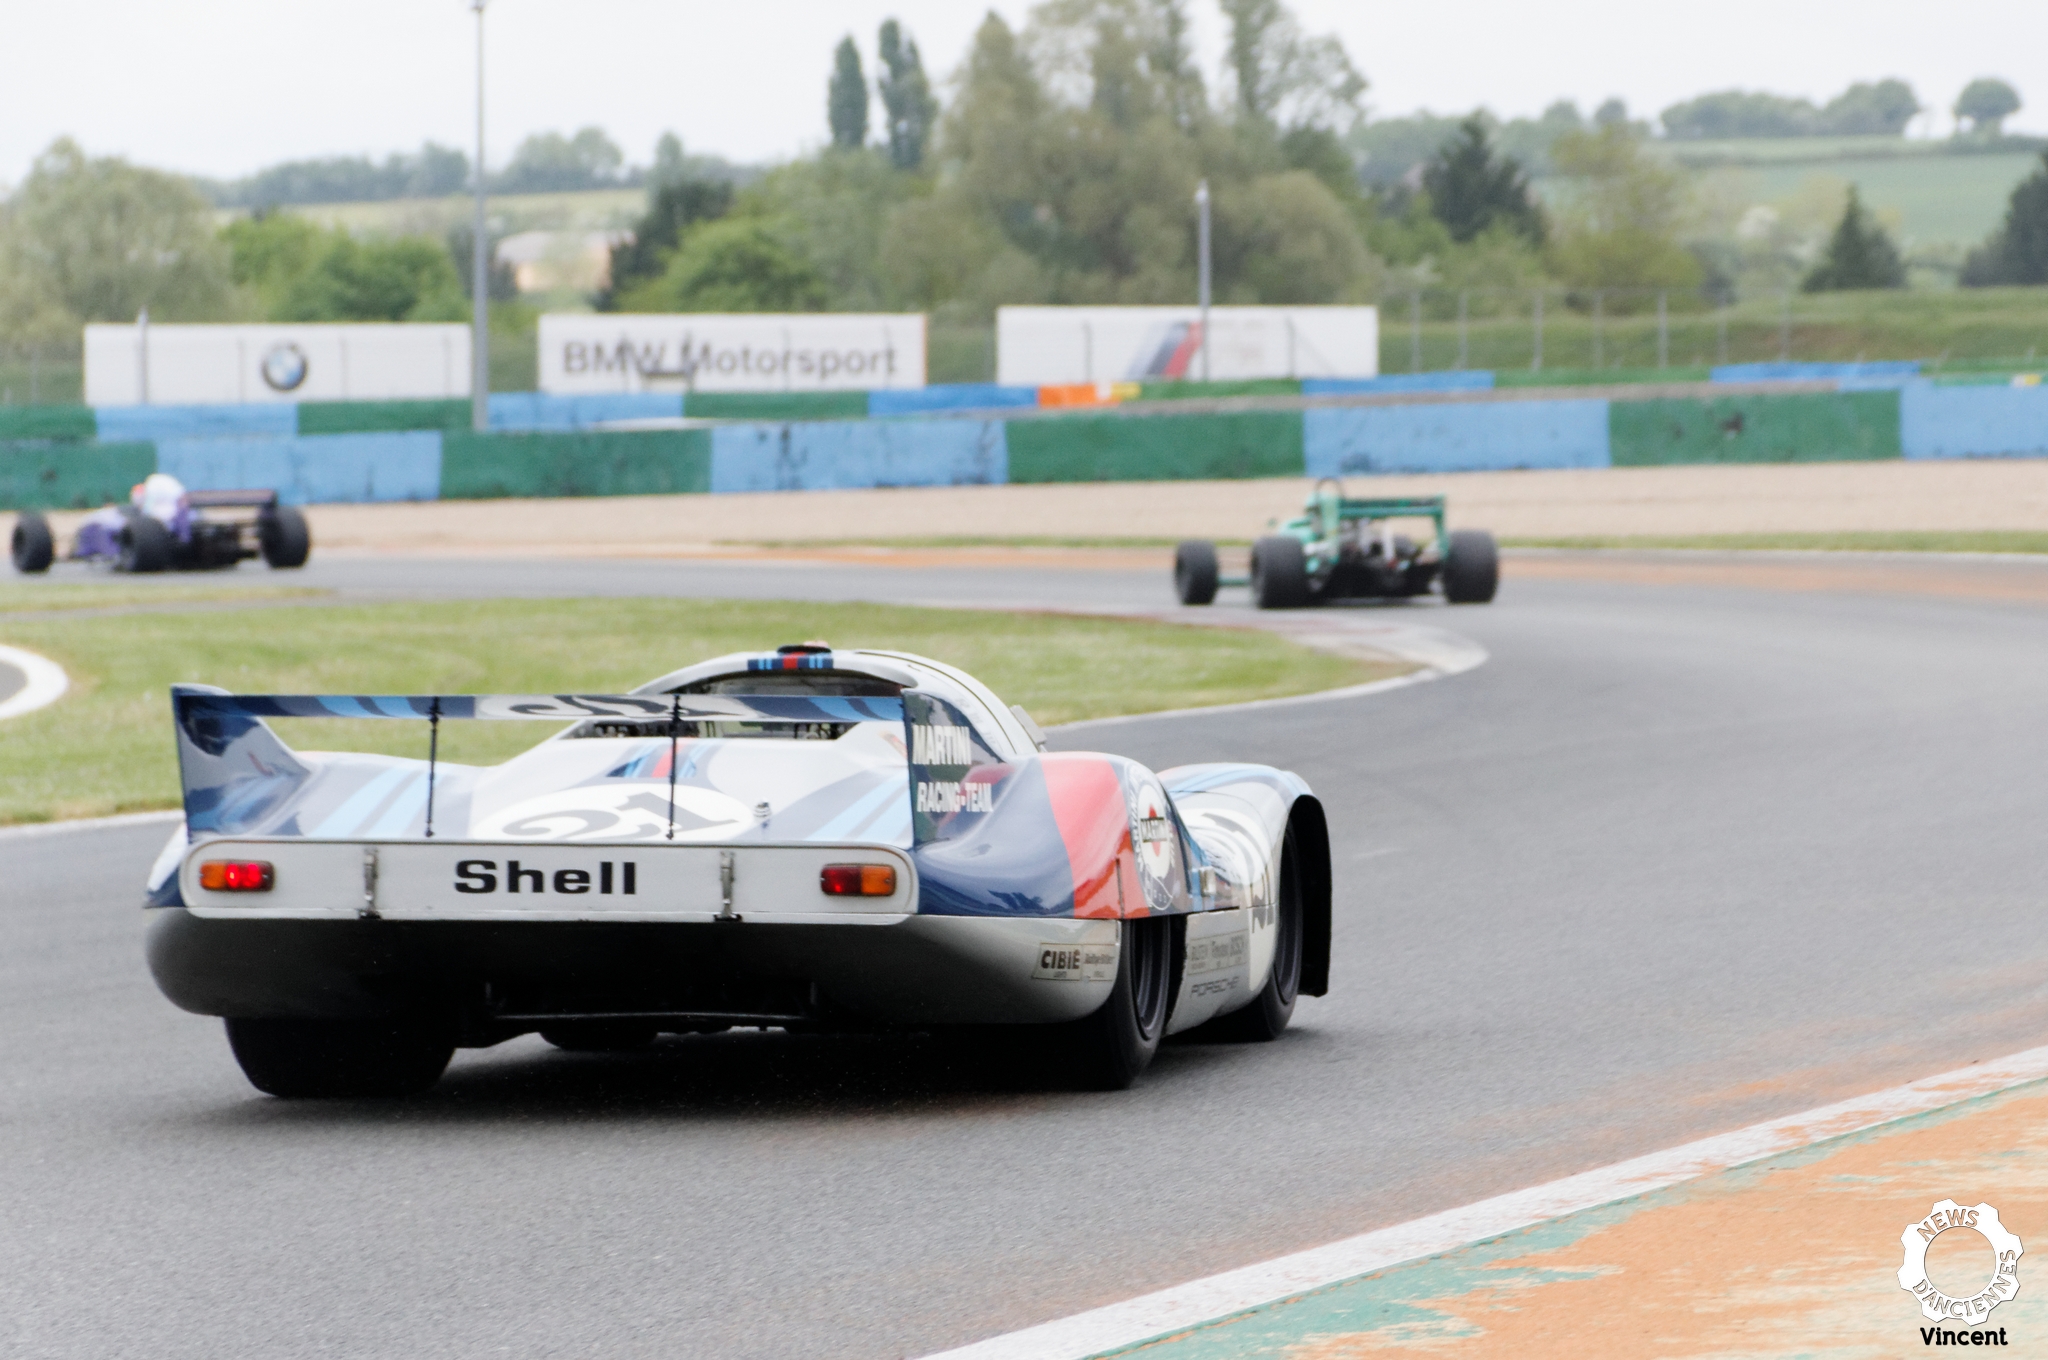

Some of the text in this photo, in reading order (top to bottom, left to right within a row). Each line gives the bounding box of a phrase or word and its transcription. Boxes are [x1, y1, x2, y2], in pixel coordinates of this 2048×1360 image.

[563, 340, 897, 381] BMW Motorsport
[911, 725, 972, 765] MARTINI
[455, 860, 637, 894] Shell
